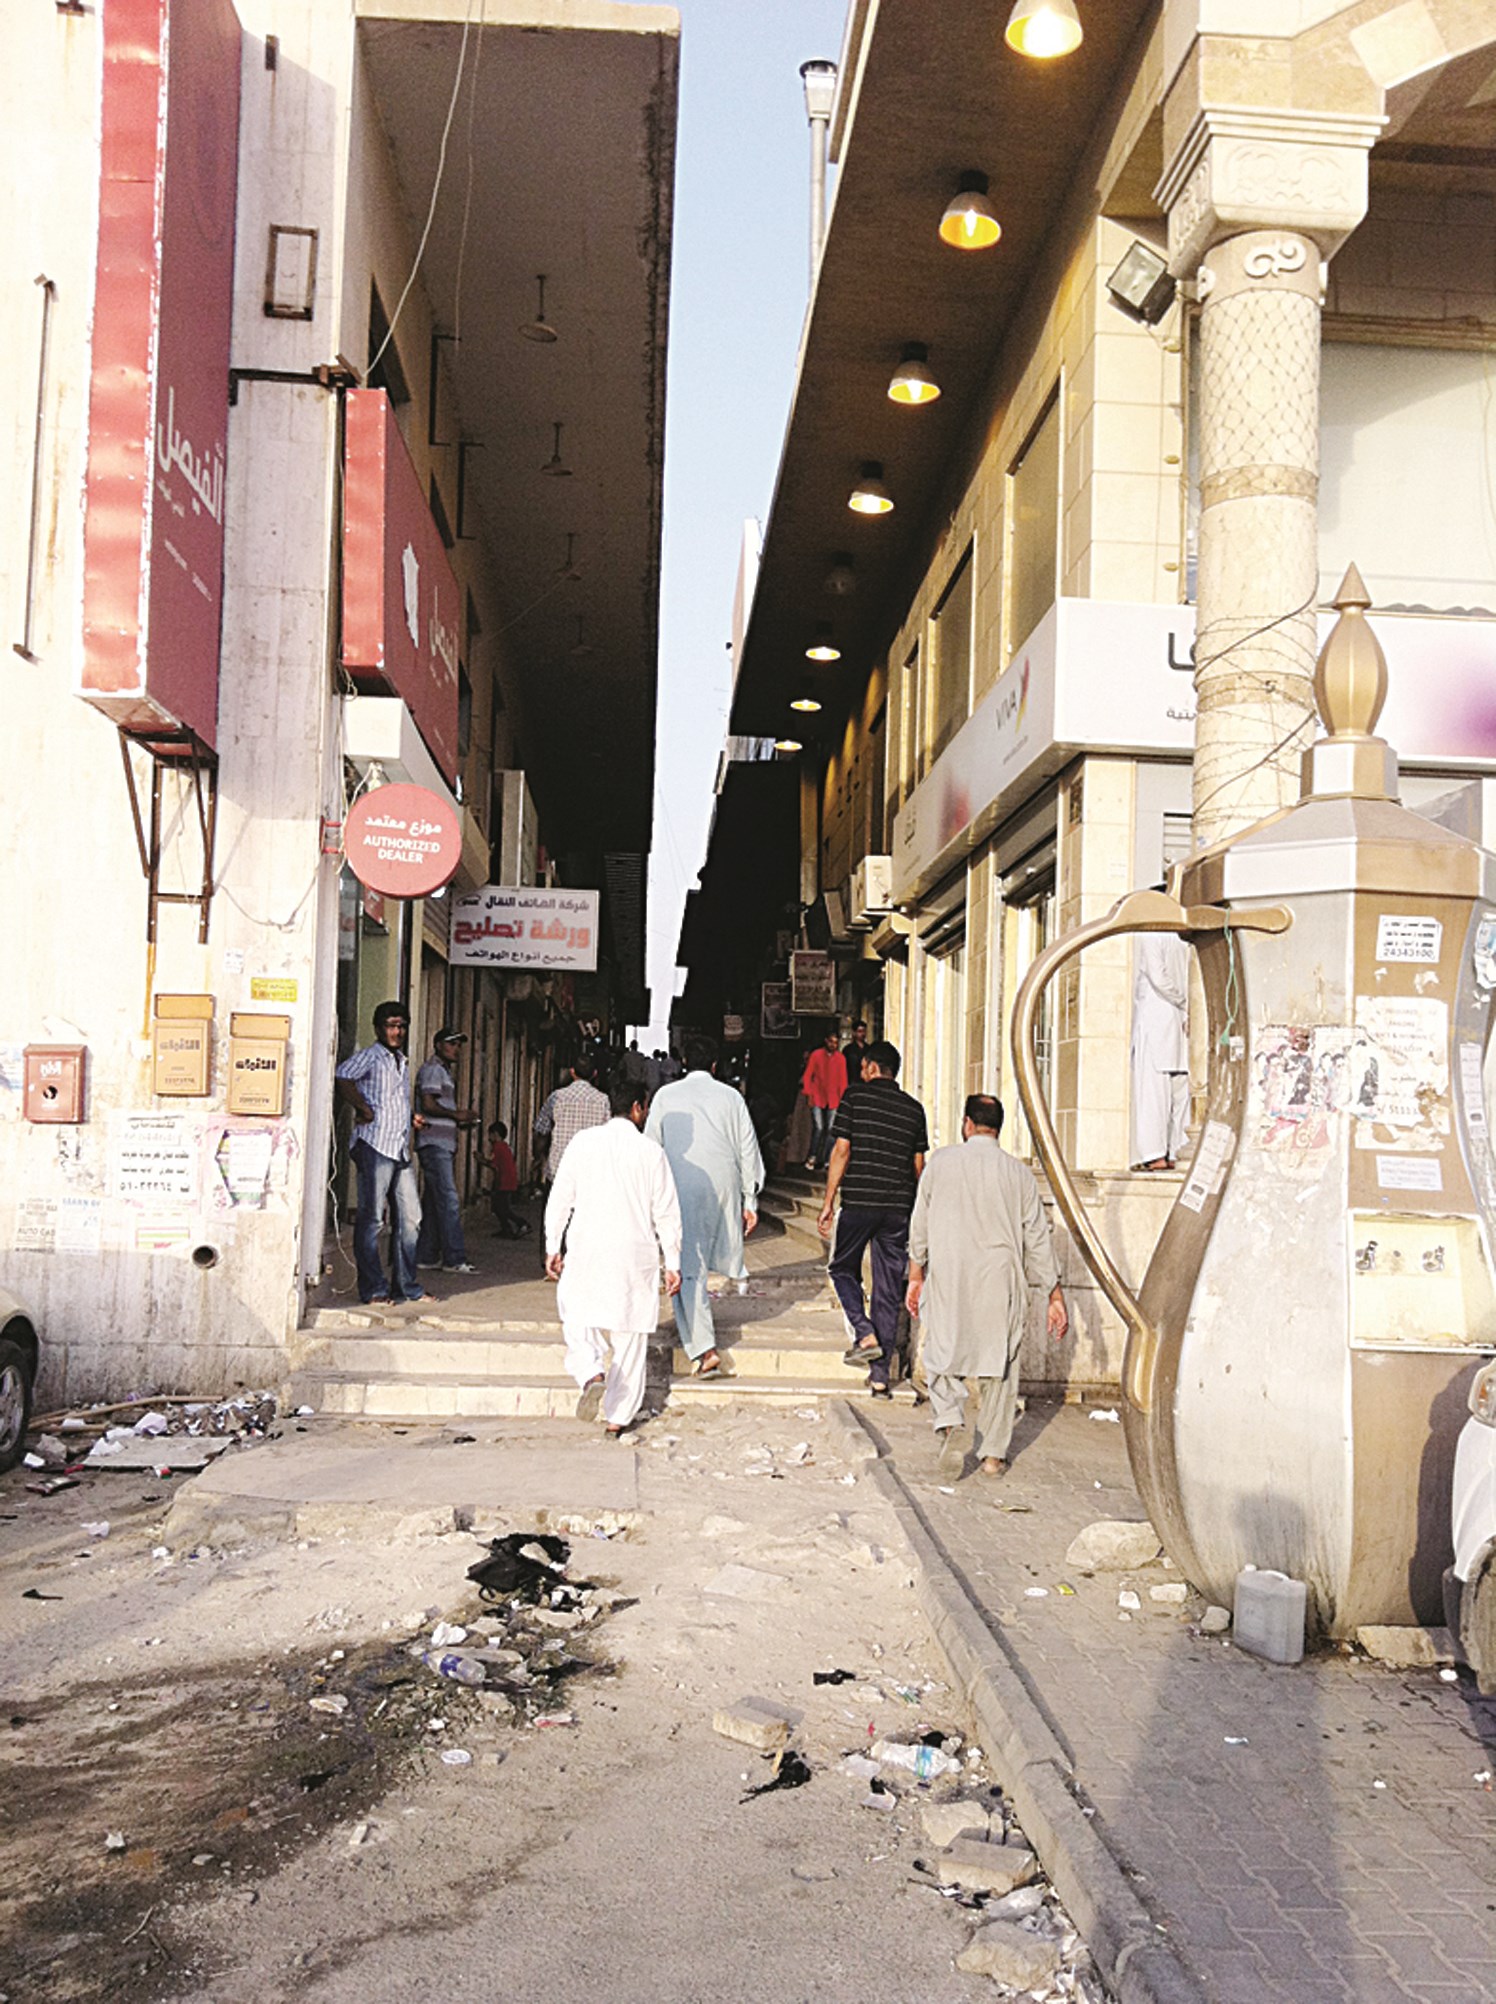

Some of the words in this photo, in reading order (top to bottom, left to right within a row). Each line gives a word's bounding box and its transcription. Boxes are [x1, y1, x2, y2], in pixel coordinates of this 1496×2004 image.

[158, 386, 223, 525] الفيصل
[995, 690, 1017, 730] VIVA
[365, 815, 407, 830] معتمد
[409, 819, 442, 837] موزع
[363, 834, 441, 854] AUTHORIZED
[377, 848, 424, 864] DEALER
[485, 895, 516, 909] النقال
[518, 897, 556, 909] الهاتف
[558, 899, 590, 913] شركة
[454, 915, 525, 945] تصليح
[530, 918, 591, 949] ورشة
[541, 953, 577, 965] جميع
